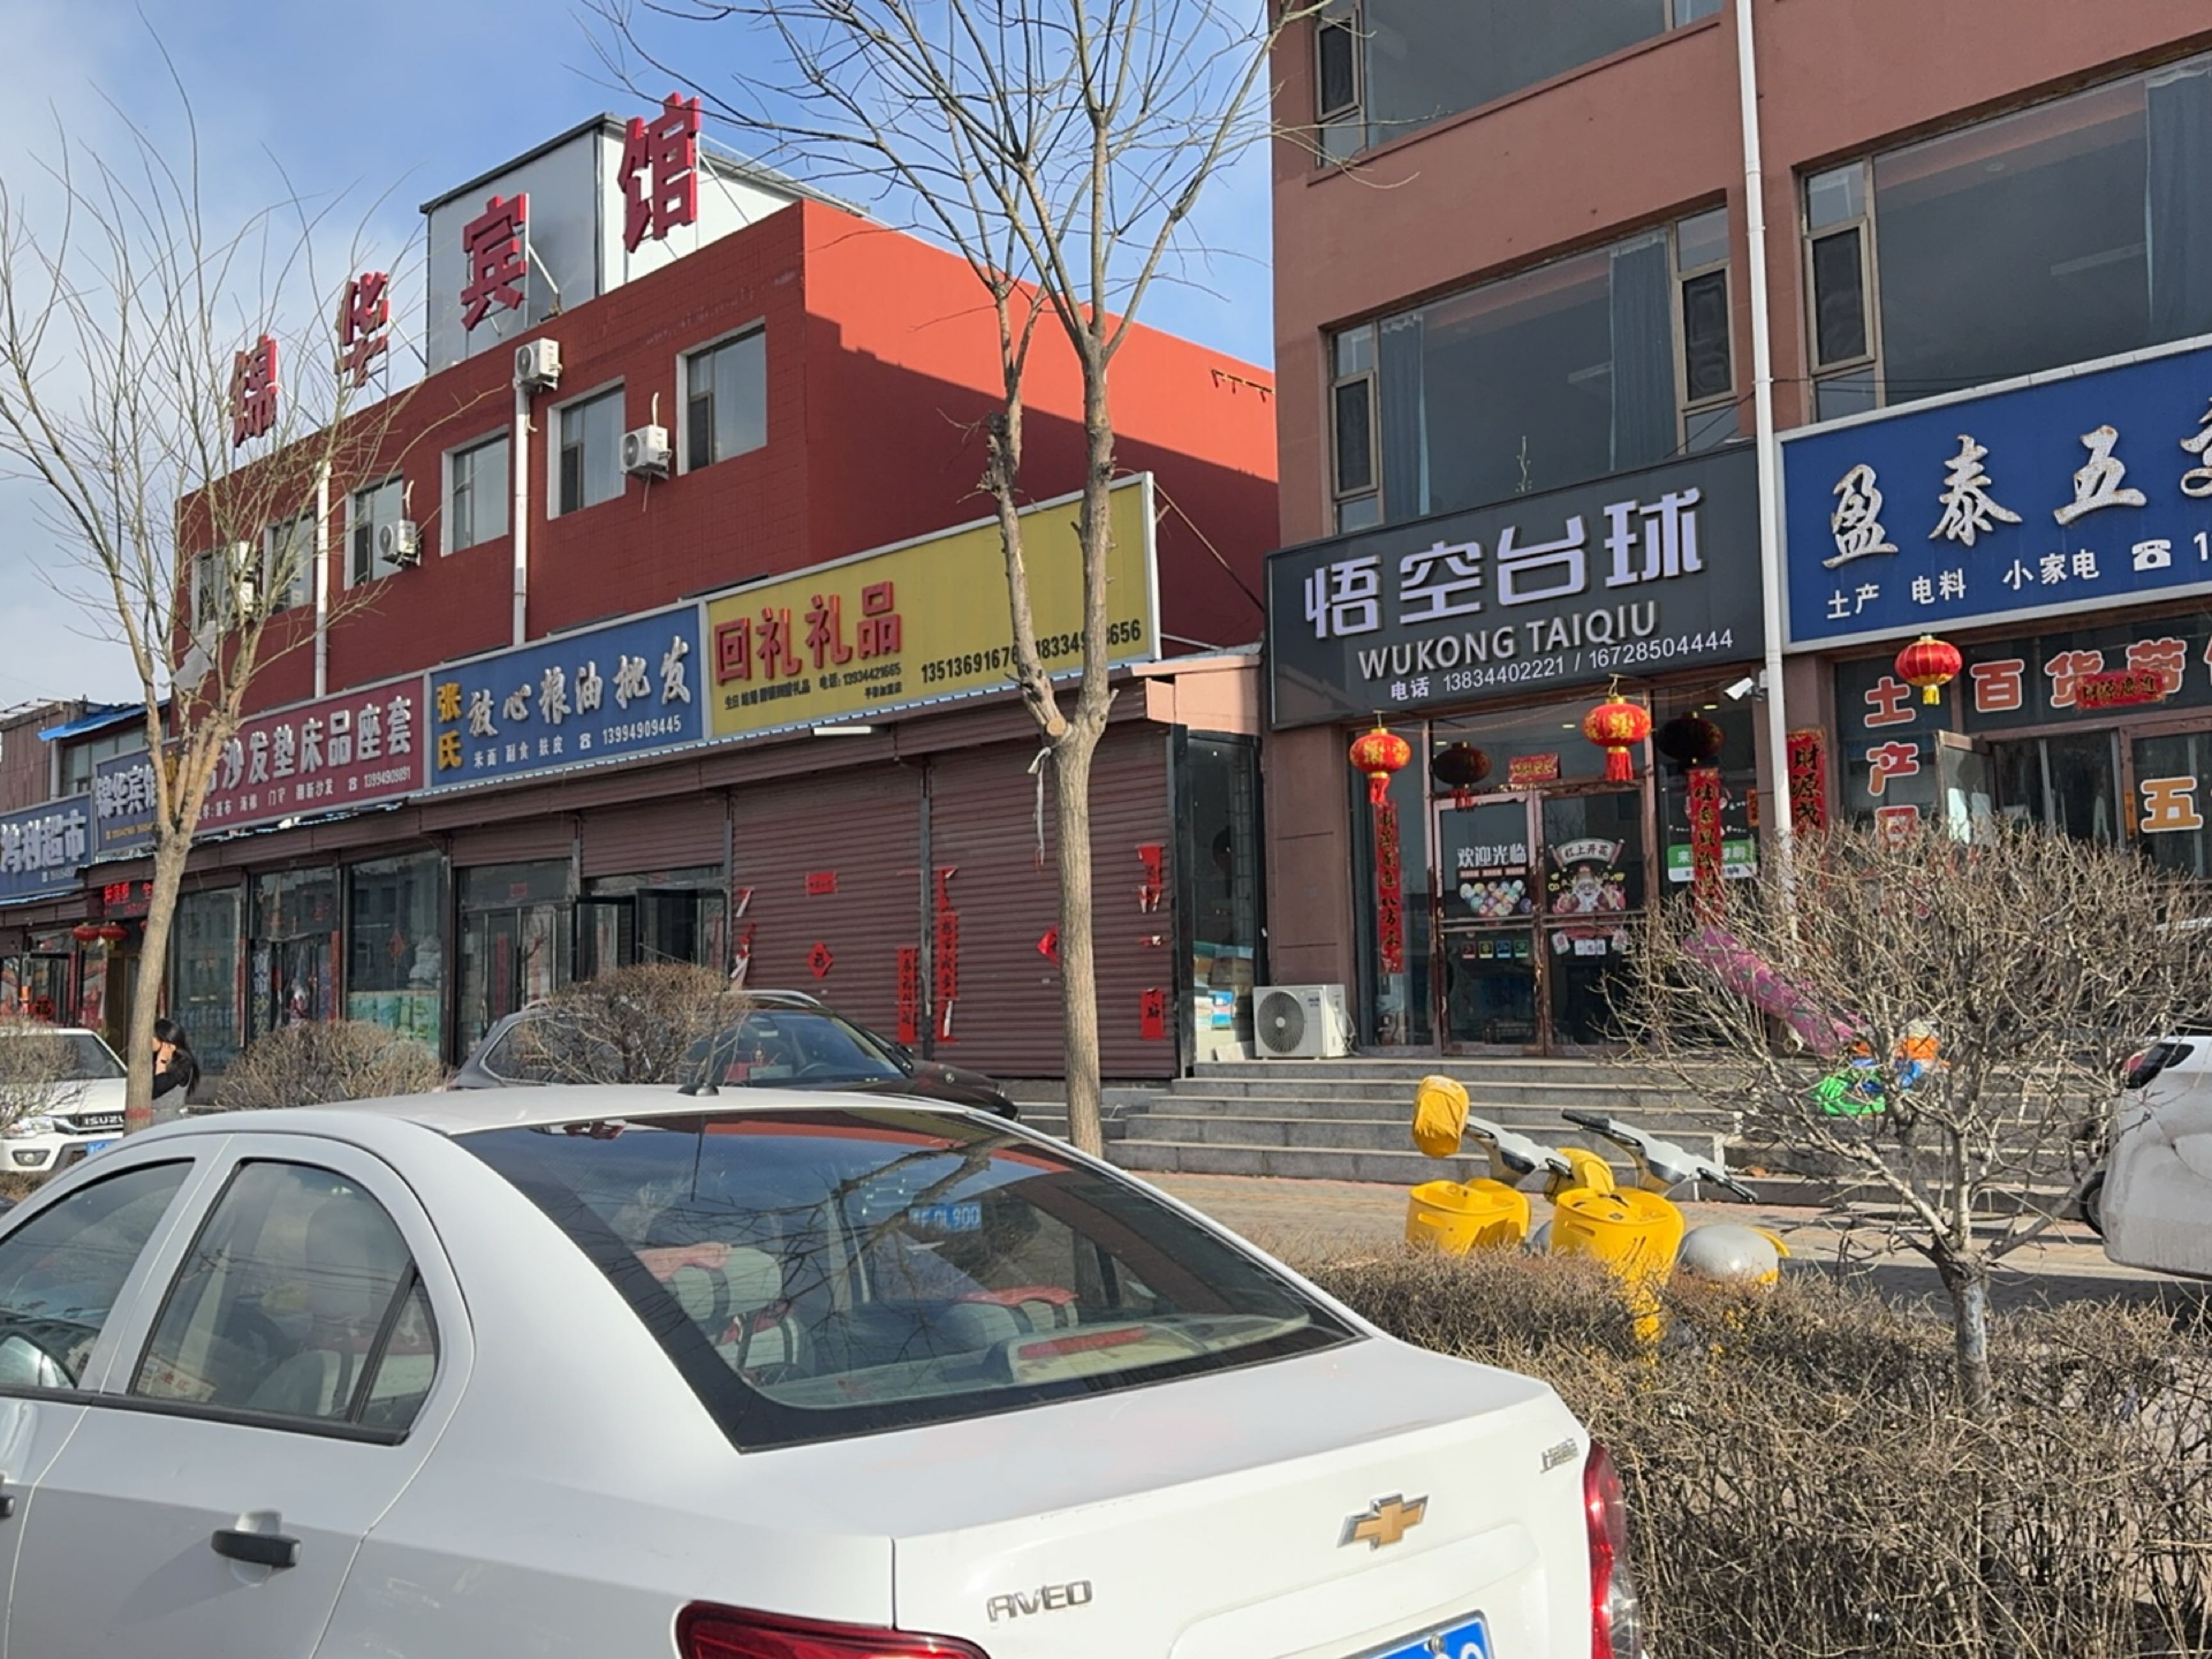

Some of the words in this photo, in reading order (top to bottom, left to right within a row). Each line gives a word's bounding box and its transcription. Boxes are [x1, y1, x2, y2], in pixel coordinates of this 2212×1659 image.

[1304, 487, 1706, 639] 悟空台球
[1827, 583, 1880, 620] 土产
[1911, 568, 1967, 605] 电料
[2003, 549, 2100, 590] 小家电
[715, 581, 902, 686] 回礼礼品
[1358, 625, 1517, 682] WUKONG
[1527, 600, 1658, 655] TAIQIU
[1391, 675, 1431, 701] 电话
[1443, 657, 1564, 692] 13834402221
[1589, 629, 1734, 669] 16728504444
[468, 636, 691, 737] 放心粮油批发
[1970, 637, 2212, 712] 百货劳
[437, 682, 463, 770] 张氏
[603, 714, 682, 746] 13994909445
[1457, 842, 1527, 867] 欢迎光临
[986, 1579, 1094, 1623] AVEO
